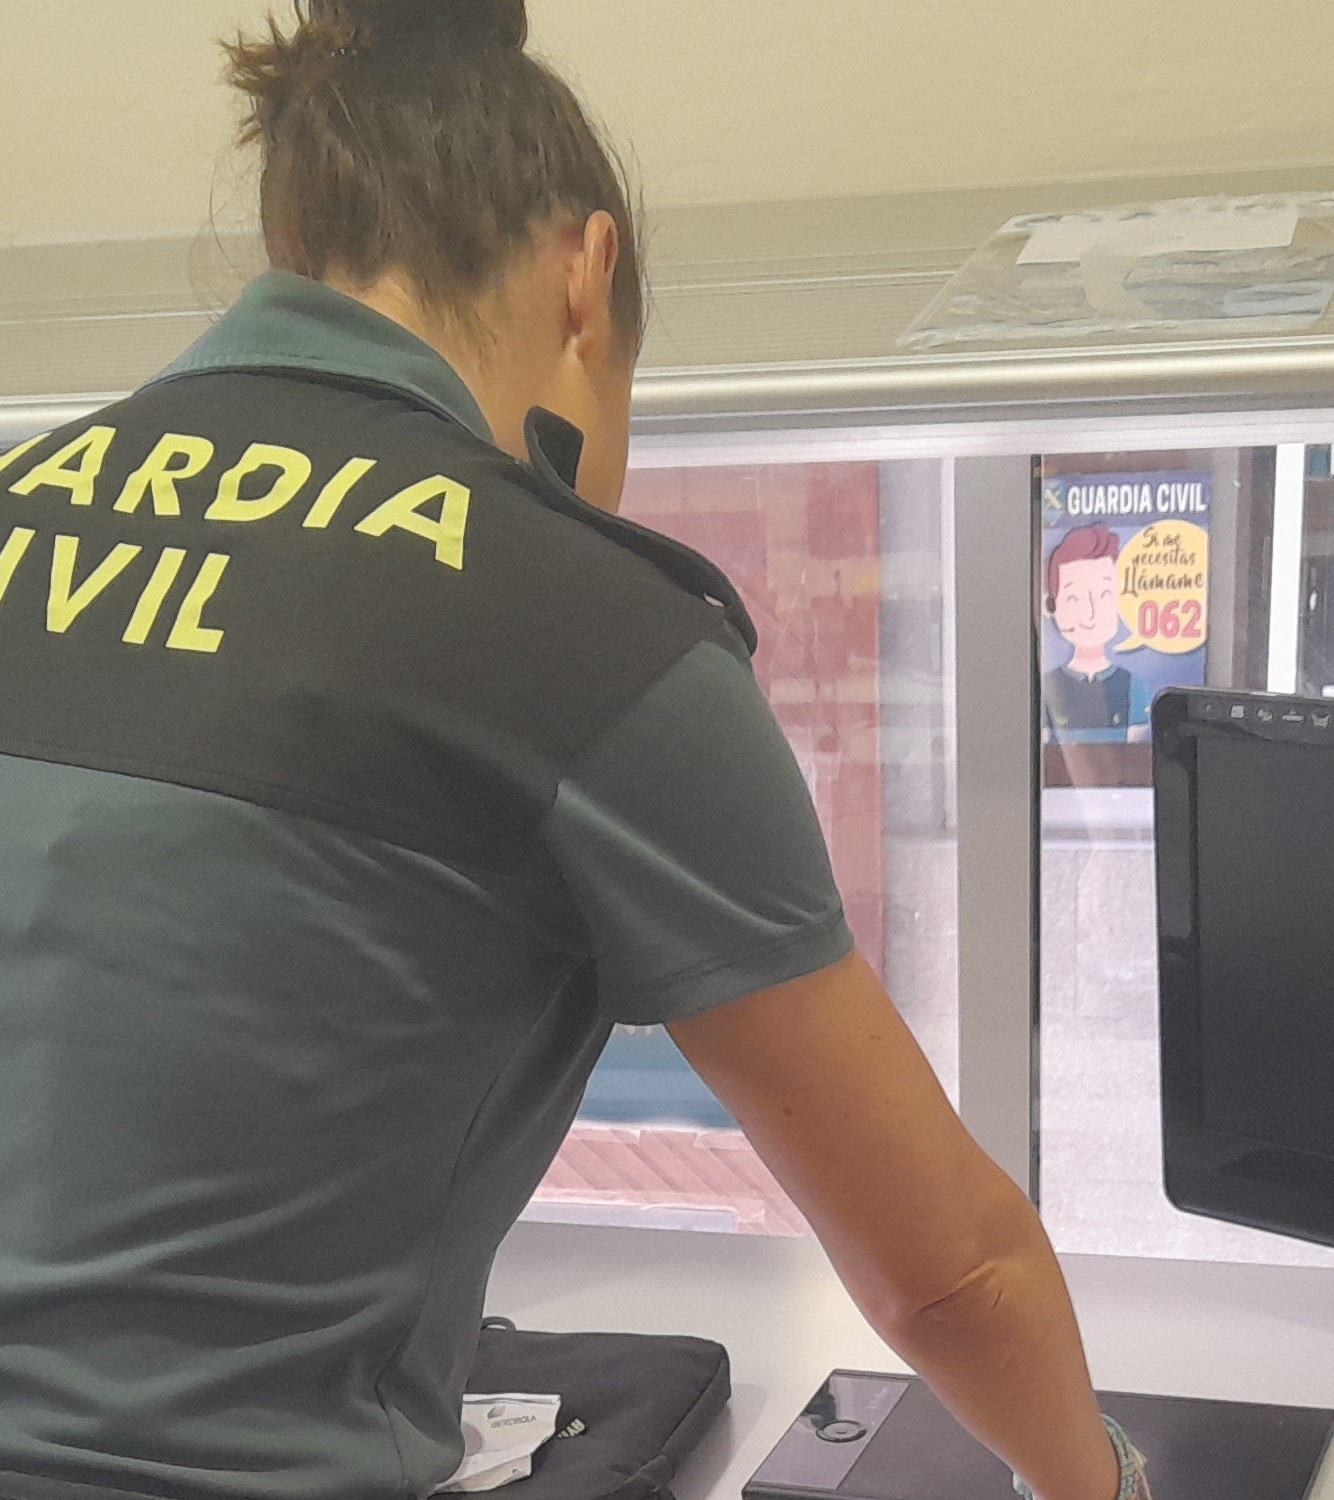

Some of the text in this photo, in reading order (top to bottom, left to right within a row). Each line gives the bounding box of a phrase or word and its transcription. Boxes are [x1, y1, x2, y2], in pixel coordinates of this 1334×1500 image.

[1067, 482, 1208, 516] GUARDIA CIVIL
[1142, 526, 1159, 548] Si
[1131, 548, 1196, 568] necesitas
[1137, 600, 1203, 639] 062
